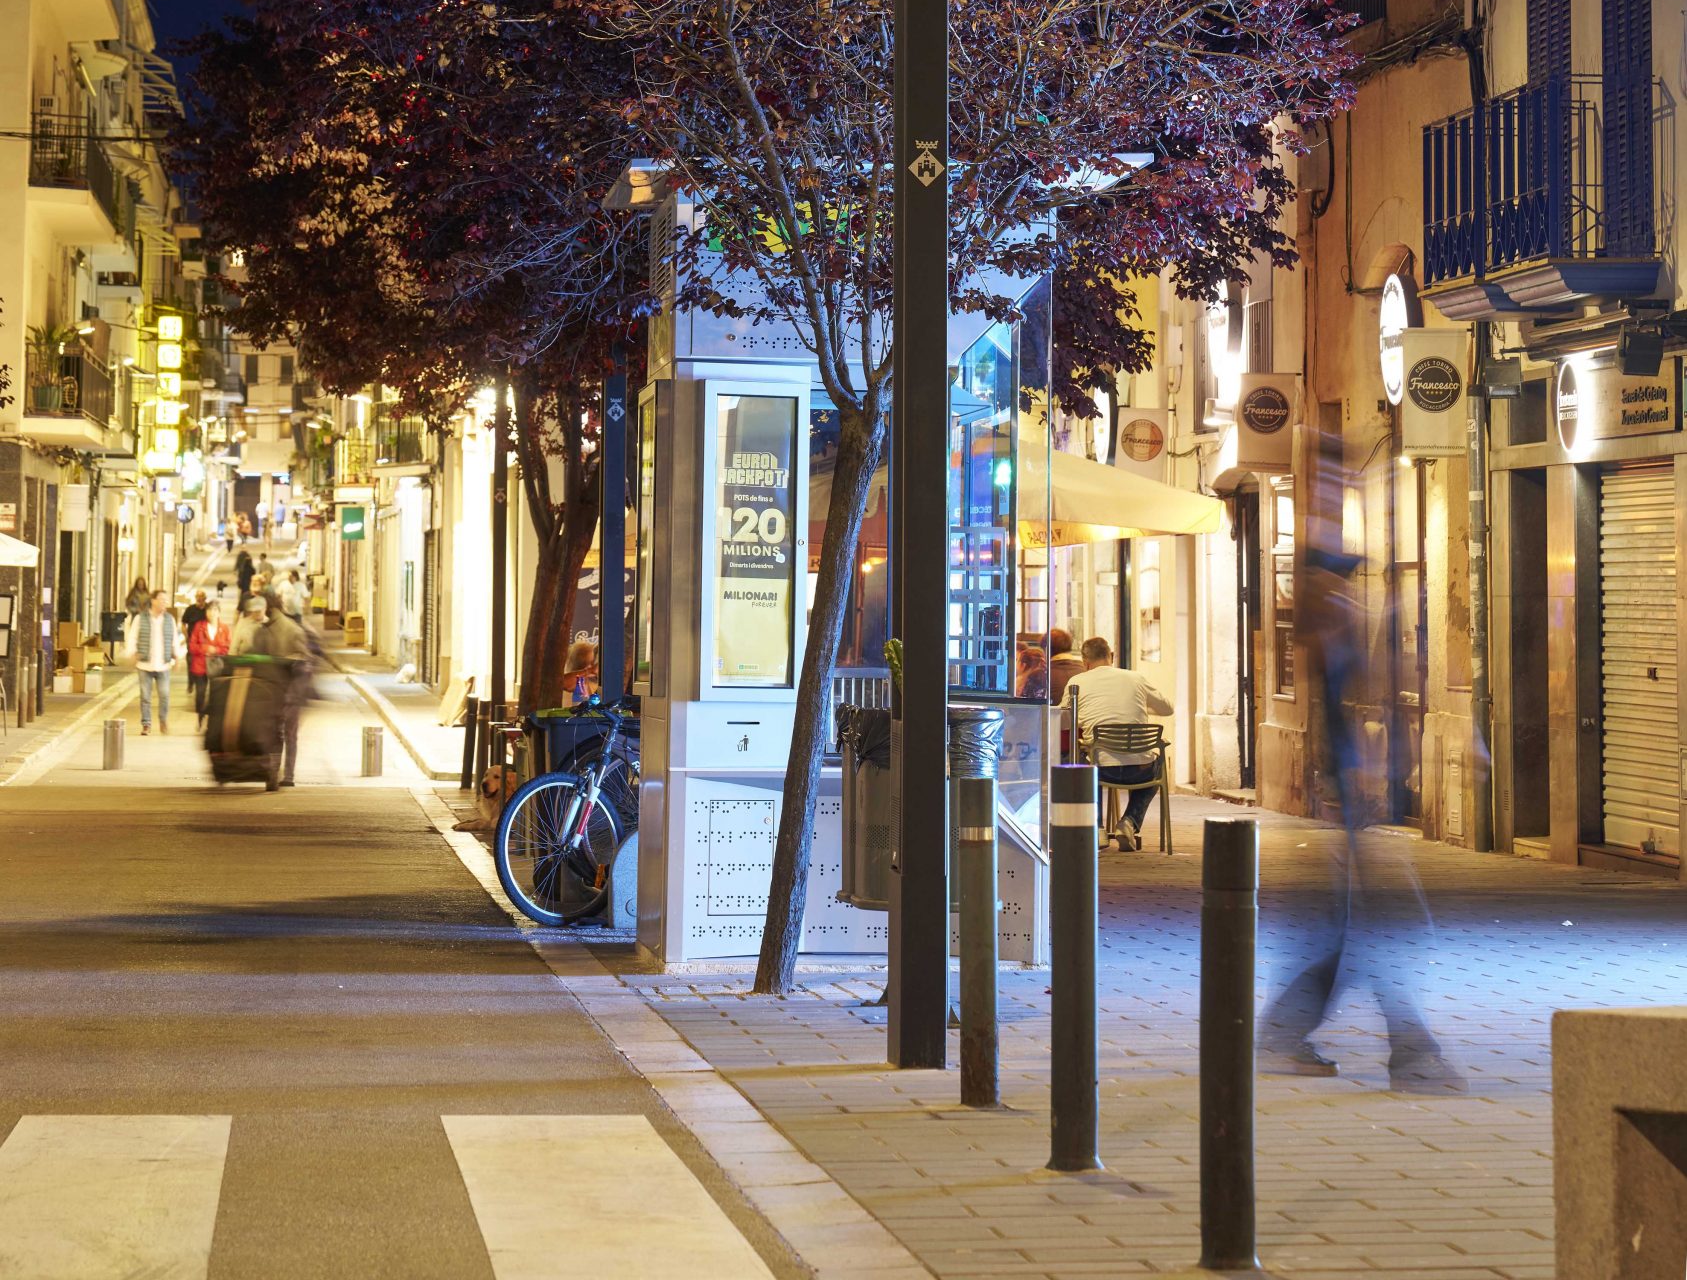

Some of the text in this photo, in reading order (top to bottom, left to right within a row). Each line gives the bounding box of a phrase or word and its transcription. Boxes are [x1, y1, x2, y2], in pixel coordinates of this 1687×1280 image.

[1432, 360, 1453, 373] TORINO
[1409, 377, 1460, 390] Francesco
[1244, 403, 1288, 415] Francesco
[1122, 433, 1161, 446] Francesco
[733, 453, 771, 469] EURO
[721, 468, 786, 487] JACKPOT
[734, 494, 749, 502] POTS
[719, 507, 786, 544] 120
[723, 544, 781, 557] MILIONS
[723, 590, 778, 602] MILIONARI
